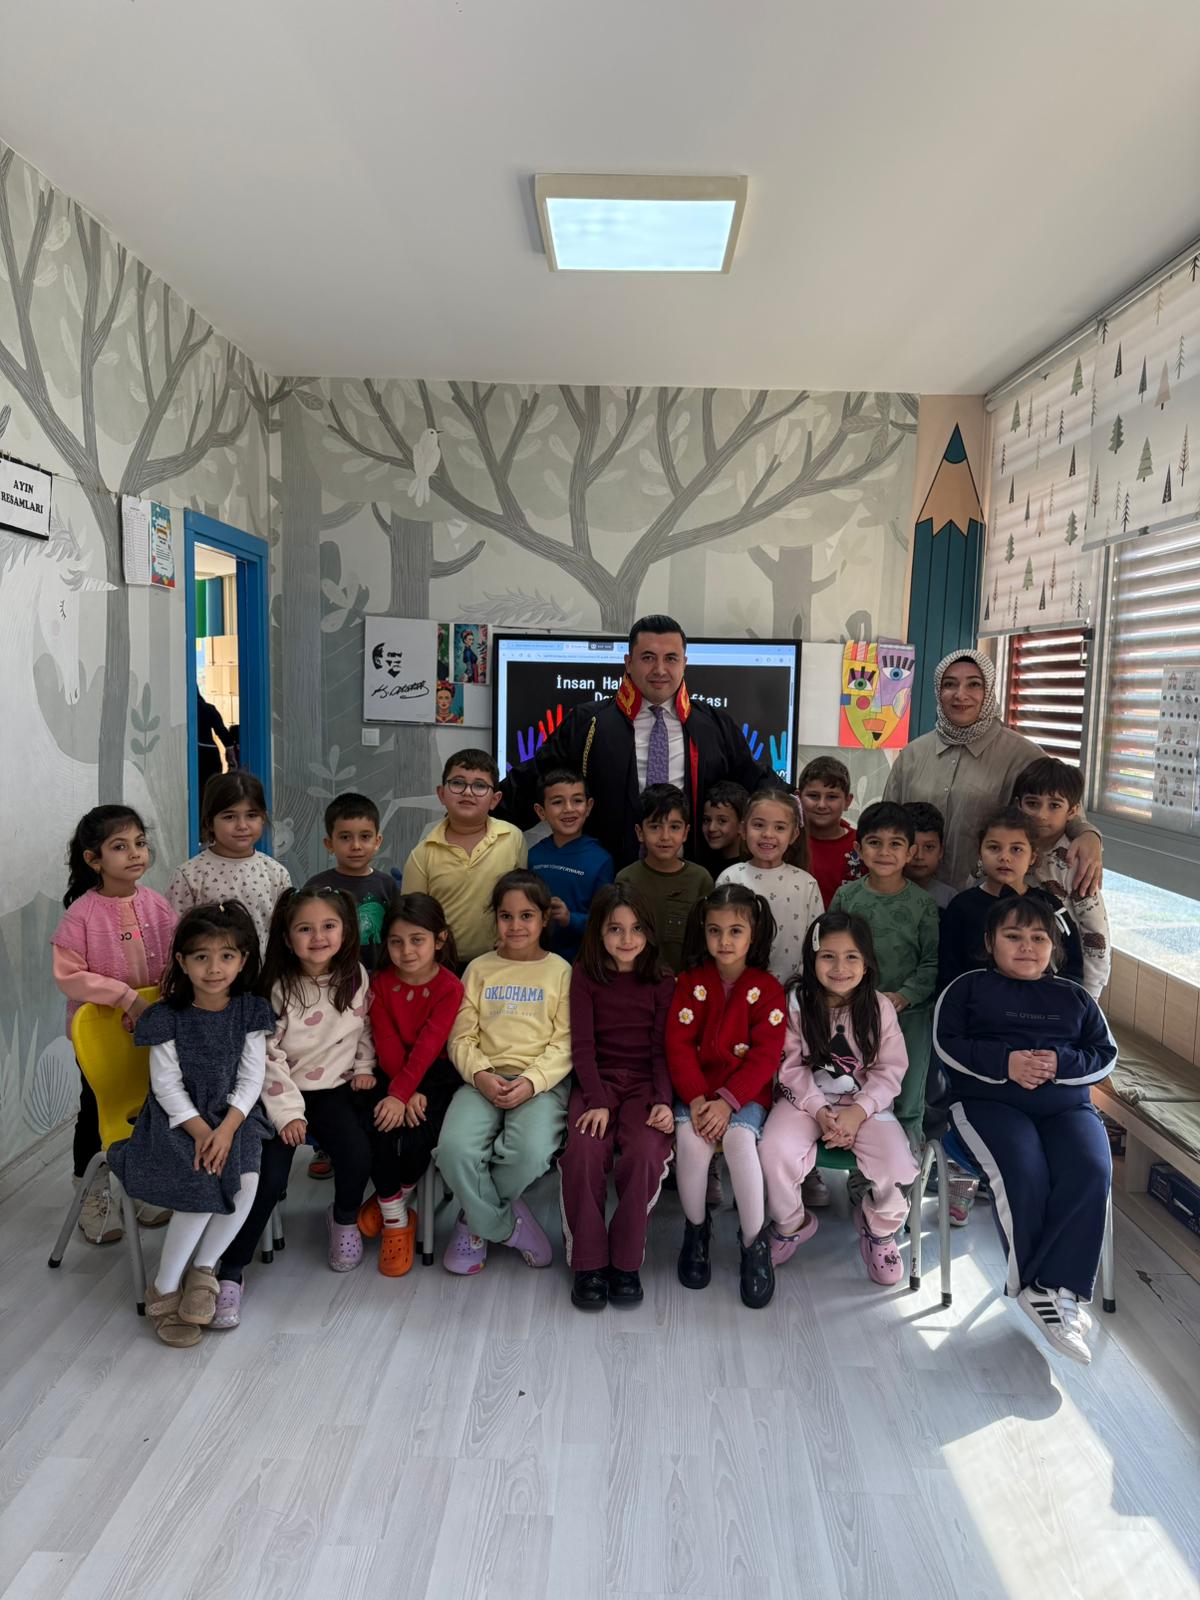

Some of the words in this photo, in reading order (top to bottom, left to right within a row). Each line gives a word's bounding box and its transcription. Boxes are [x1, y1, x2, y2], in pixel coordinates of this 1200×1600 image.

[13, 479, 34, 494] AYIN
[556, 674, 595, 690] İnsan
[484, 985, 544, 1002] OKLOHAMA
